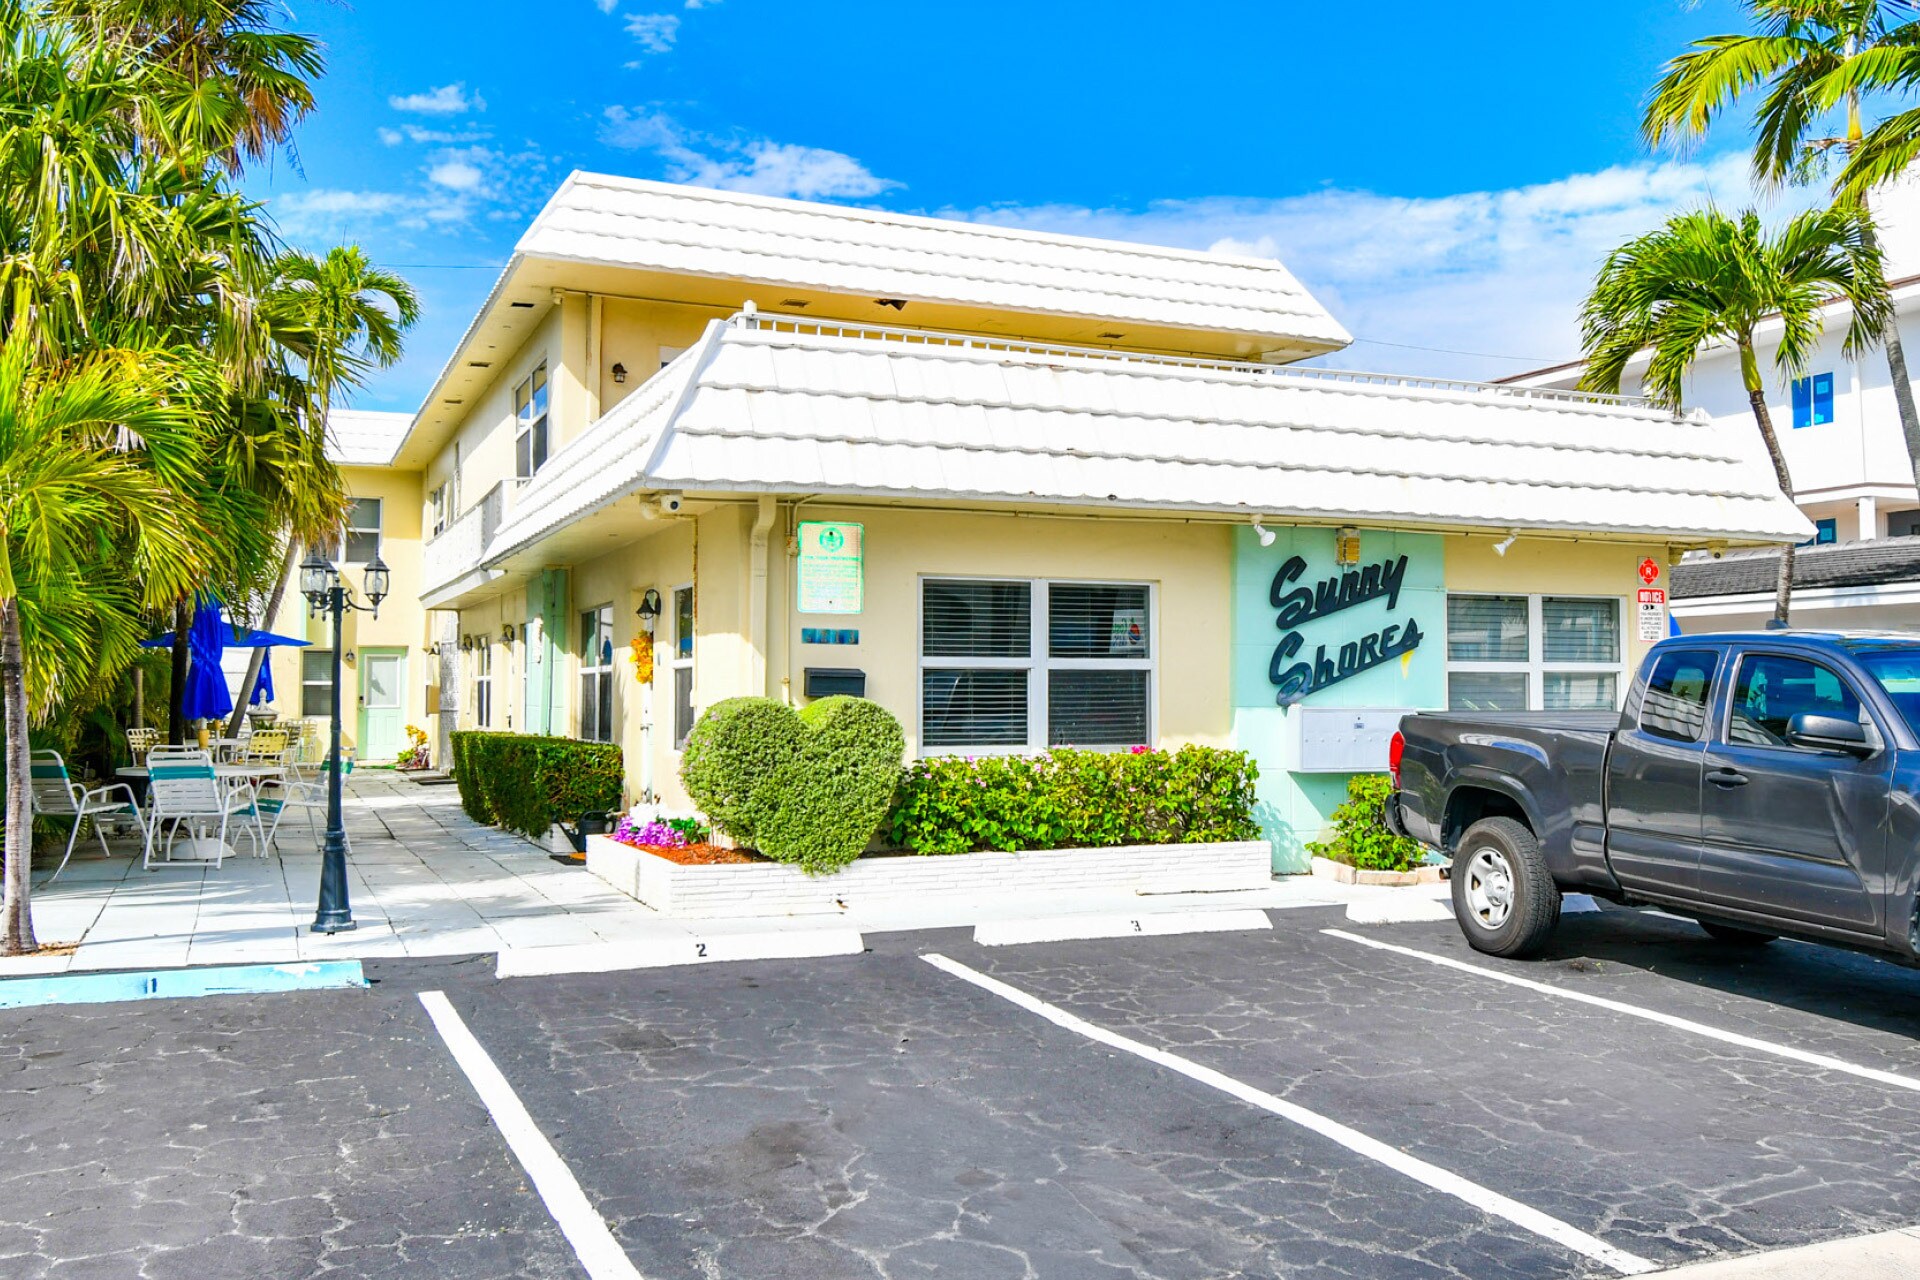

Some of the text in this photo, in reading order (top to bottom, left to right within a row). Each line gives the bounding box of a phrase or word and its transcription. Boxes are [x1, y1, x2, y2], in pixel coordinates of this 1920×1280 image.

[1645, 566, 1652, 576] R
[1269, 555, 1409, 630] Sunny
[695, 942, 708, 958] 2
[150, 977, 158, 994] 1
